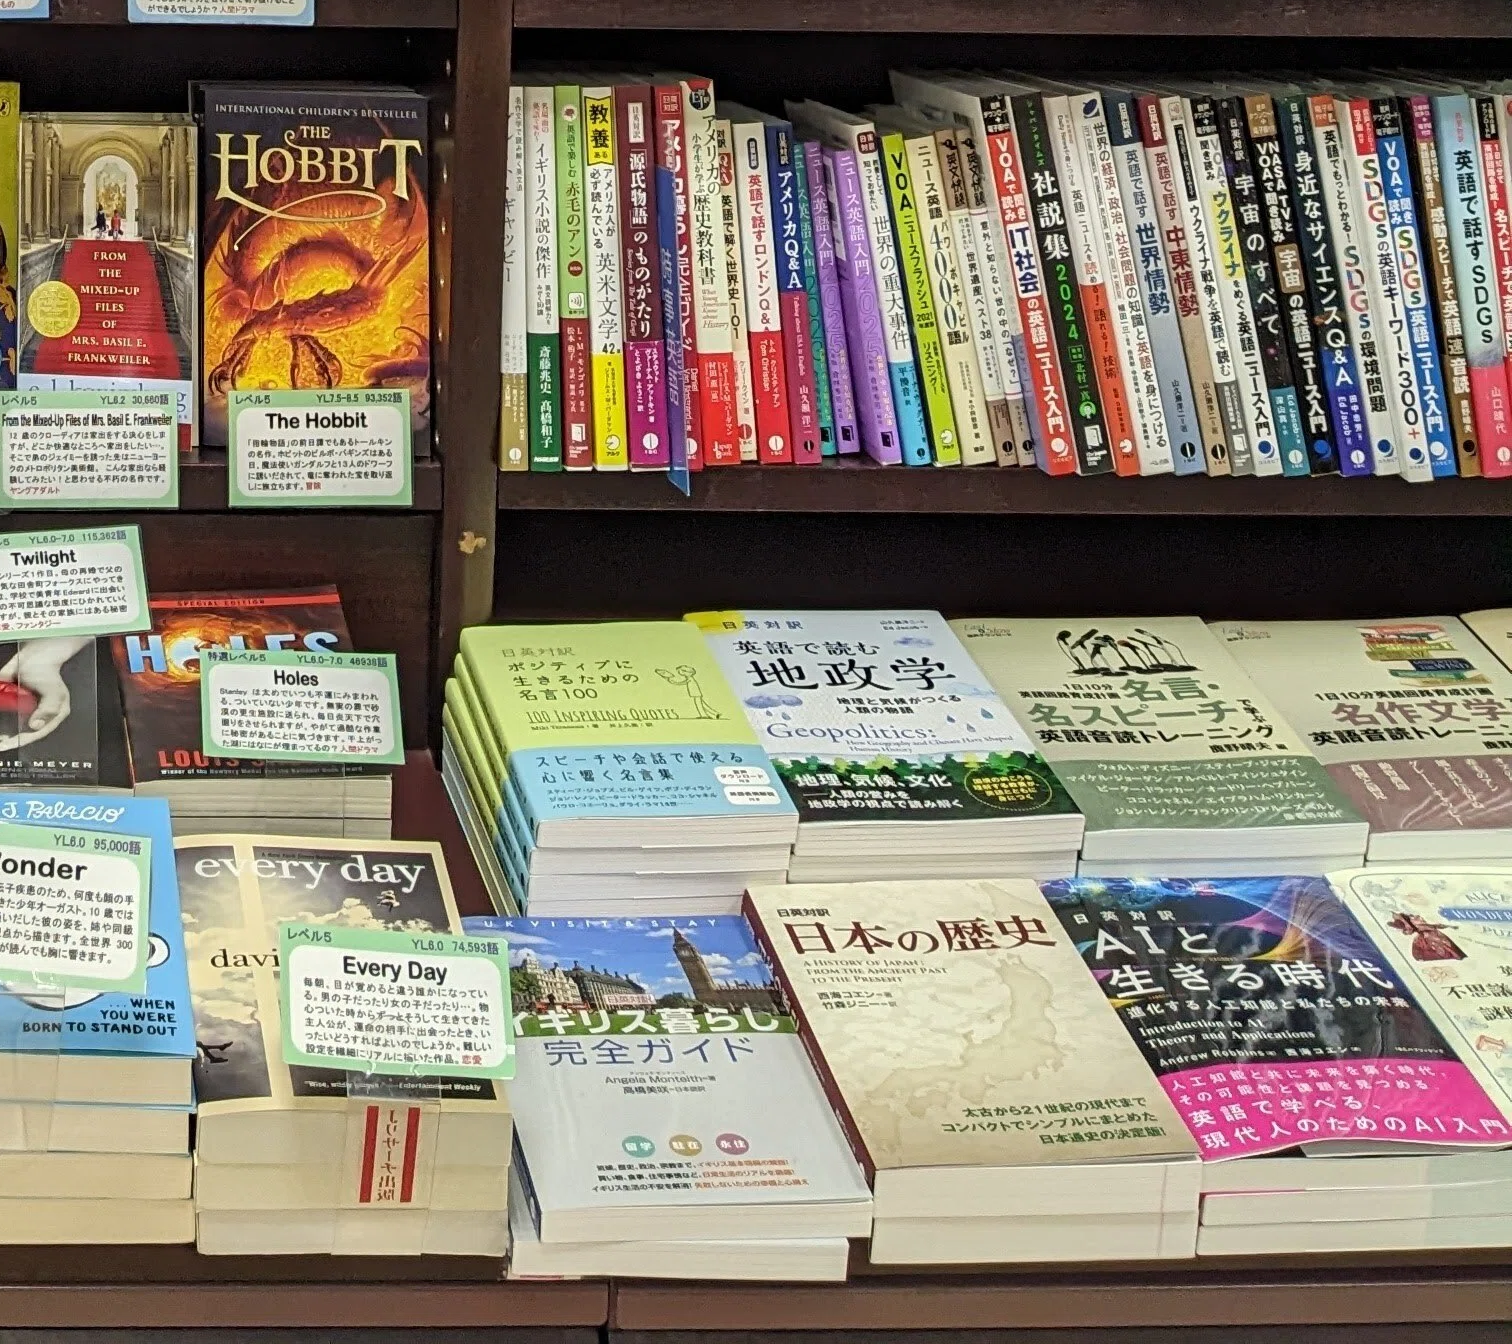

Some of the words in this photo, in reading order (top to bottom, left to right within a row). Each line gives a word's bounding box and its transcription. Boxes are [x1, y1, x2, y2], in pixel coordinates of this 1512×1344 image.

[215, 104, 294, 116] INTERNATIONAL
[298, 106, 358, 117] CHILDREN'S
[361, 108, 419, 119] BESTSELLER
[300, 126, 330, 140] THE
[212, 131, 422, 201] HOBBIT
[1031, 172, 1070, 260] 社説集
[93, 251, 127, 261] FROM
[1135, 223, 1170, 314] 世界情勢
[1166, 226, 1200, 316] 中東情勢
[81, 286, 140, 296] MIXED-UP
[595, 252, 619, 339] 英米文学
[95, 302, 124, 312] FILES
[67, 353, 151, 365] FRANKWEILER
[265, 412, 304, 429] The
[306, 412, 368, 429] Hobbit
[12, 549, 77, 568] Twilight
[732, 640, 881, 657] 英語で読む
[273, 670, 319, 688] Holes
[745, 657, 956, 691] 地政学
[1040, 723, 1275, 744] 英語音読トレーニング
[33, 760, 94, 770] MEYER
[782, 915, 1058, 956] 日本の歴史
[343, 956, 402, 981] Every
[408, 961, 447, 984] Day
[1109, 958, 1394, 998] 生きる時代
[22, 1021, 61, 1033] BORN
[65, 1022, 87, 1033] TO
[90, 1023, 140, 1035] STAND
[144, 1025, 178, 1036] OUT
[543, 1038, 753, 1066] 完全ガイド
